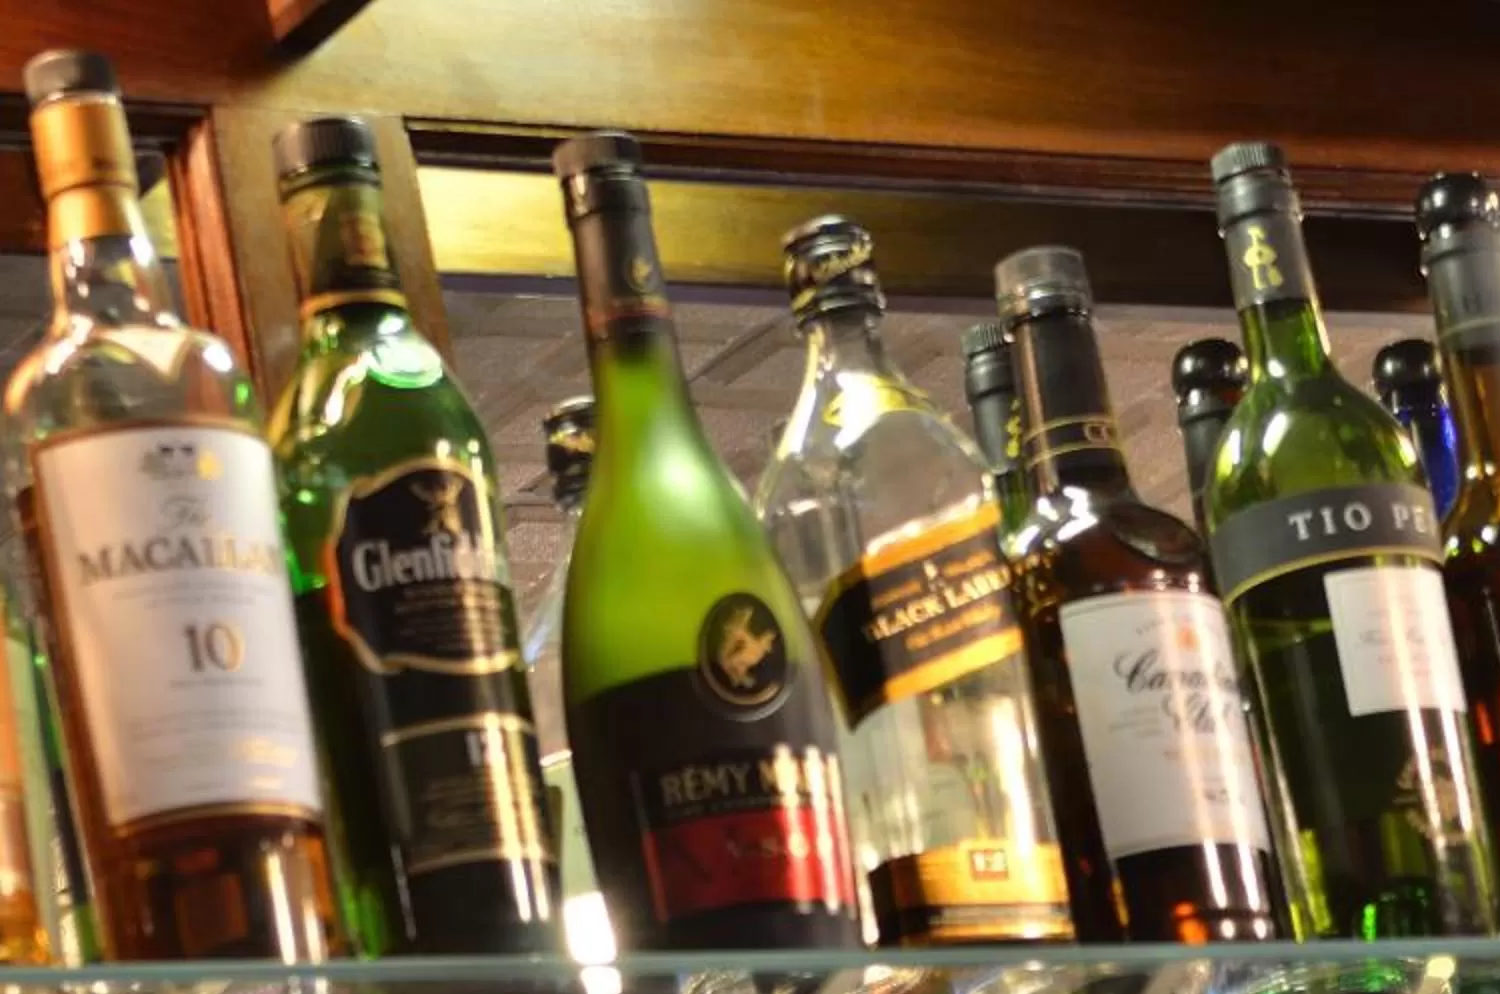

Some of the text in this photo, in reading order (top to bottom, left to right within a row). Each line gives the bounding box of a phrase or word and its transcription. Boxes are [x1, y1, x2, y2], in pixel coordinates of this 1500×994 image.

[1288, 502, 1434, 541] TIO PE
[185, 619, 246, 673] 10
